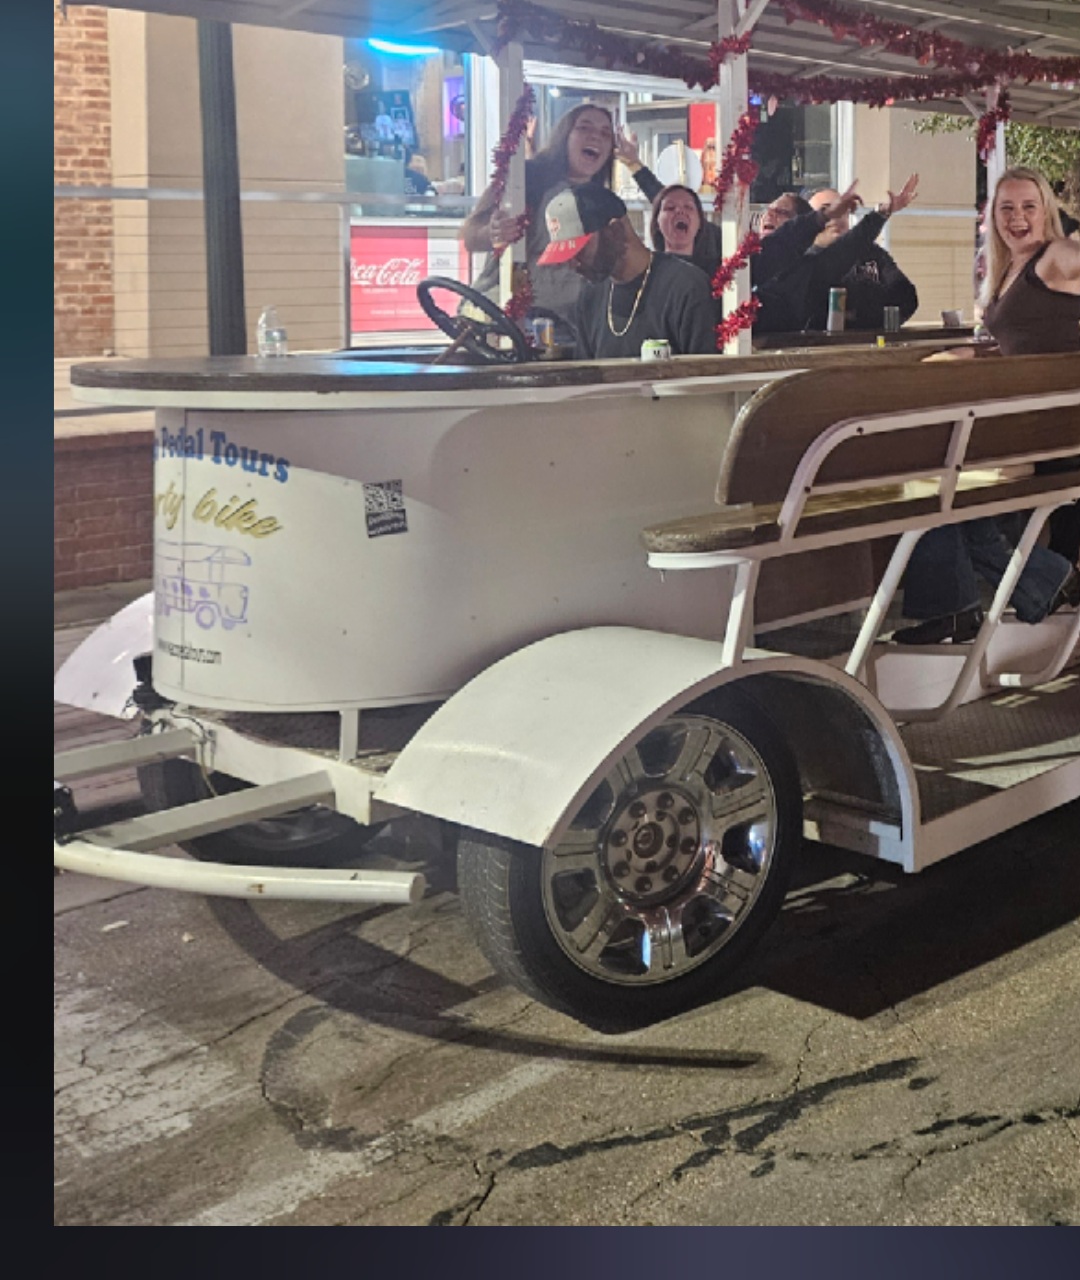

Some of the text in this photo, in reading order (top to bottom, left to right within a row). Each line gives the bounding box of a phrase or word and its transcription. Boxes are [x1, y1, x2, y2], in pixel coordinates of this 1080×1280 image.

[161, 426, 204, 461] Pedal
[210, 429, 290, 483] Tours
[191, 486, 283, 538] bike
